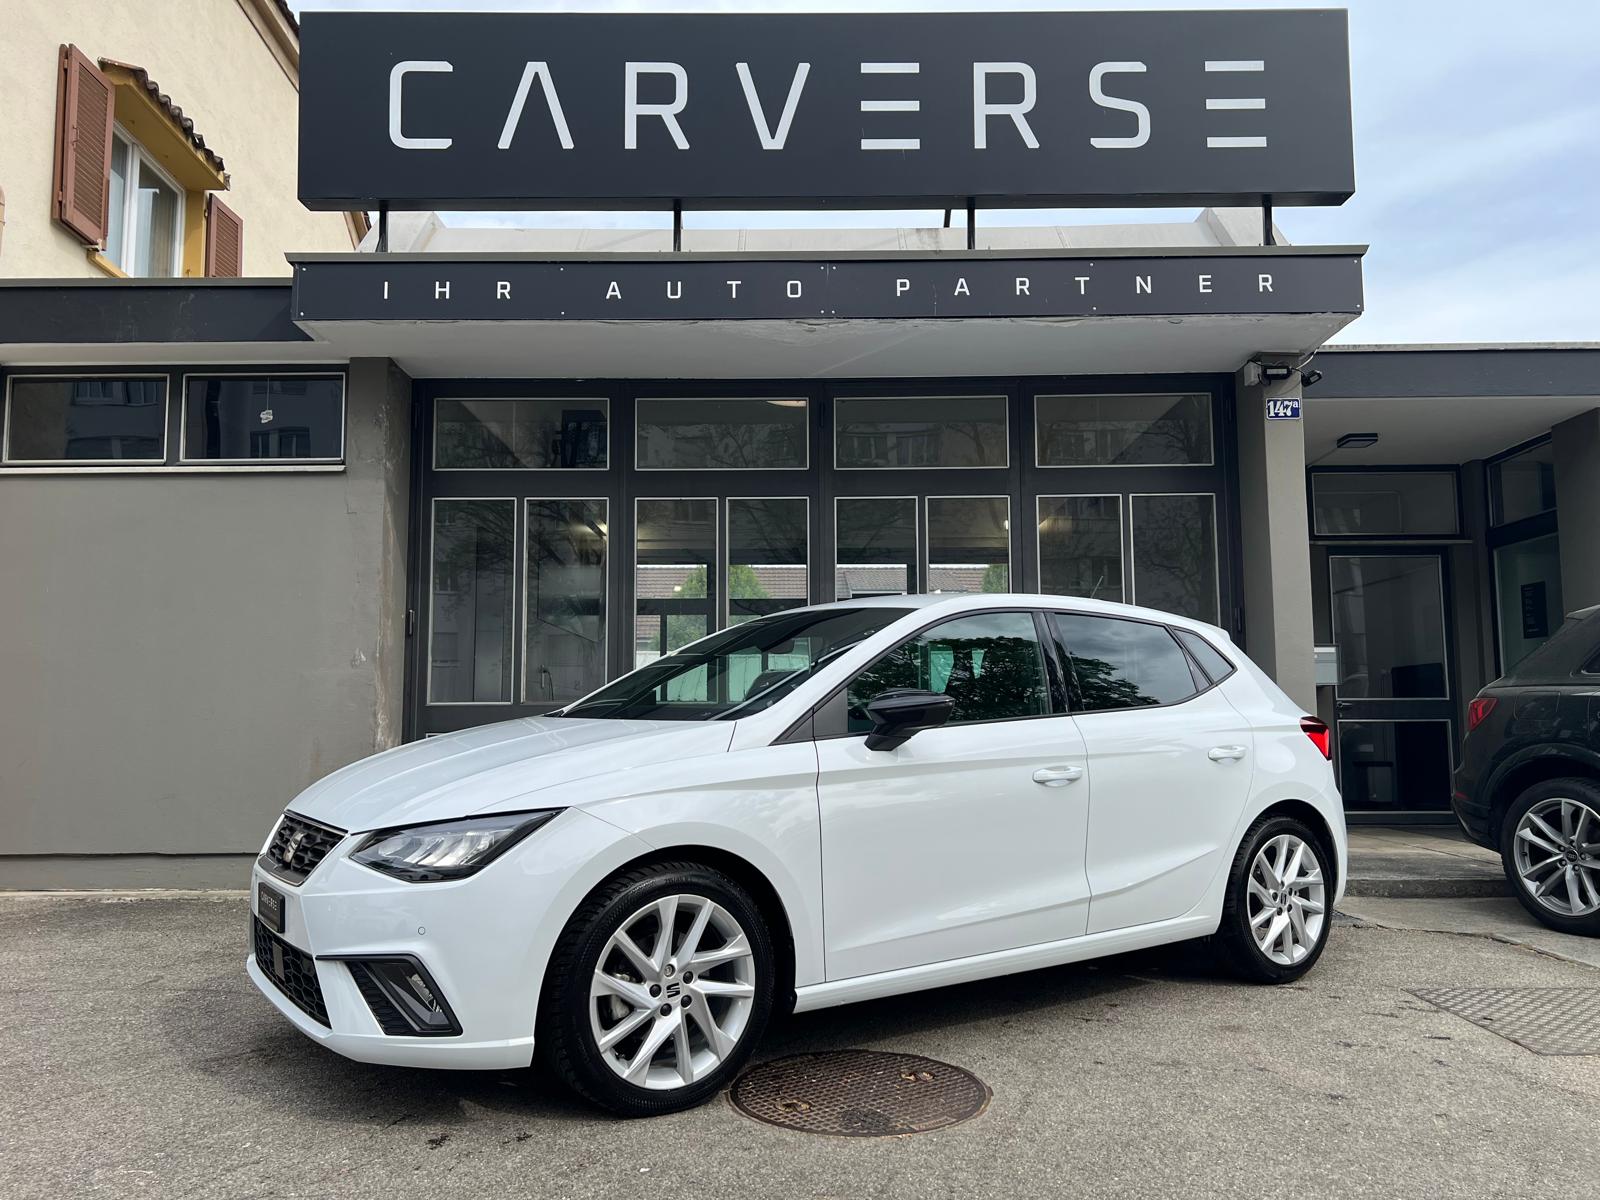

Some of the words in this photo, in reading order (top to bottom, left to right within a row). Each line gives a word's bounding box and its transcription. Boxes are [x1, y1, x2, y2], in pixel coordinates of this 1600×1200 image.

[388, 60, 1268, 151] CARVERSE
[383, 280, 511, 300] IHR
[605, 279, 803, 299] AUTO
[896, 273, 1274, 297] PARTNER
[1267, 400, 1299, 417] 147a
